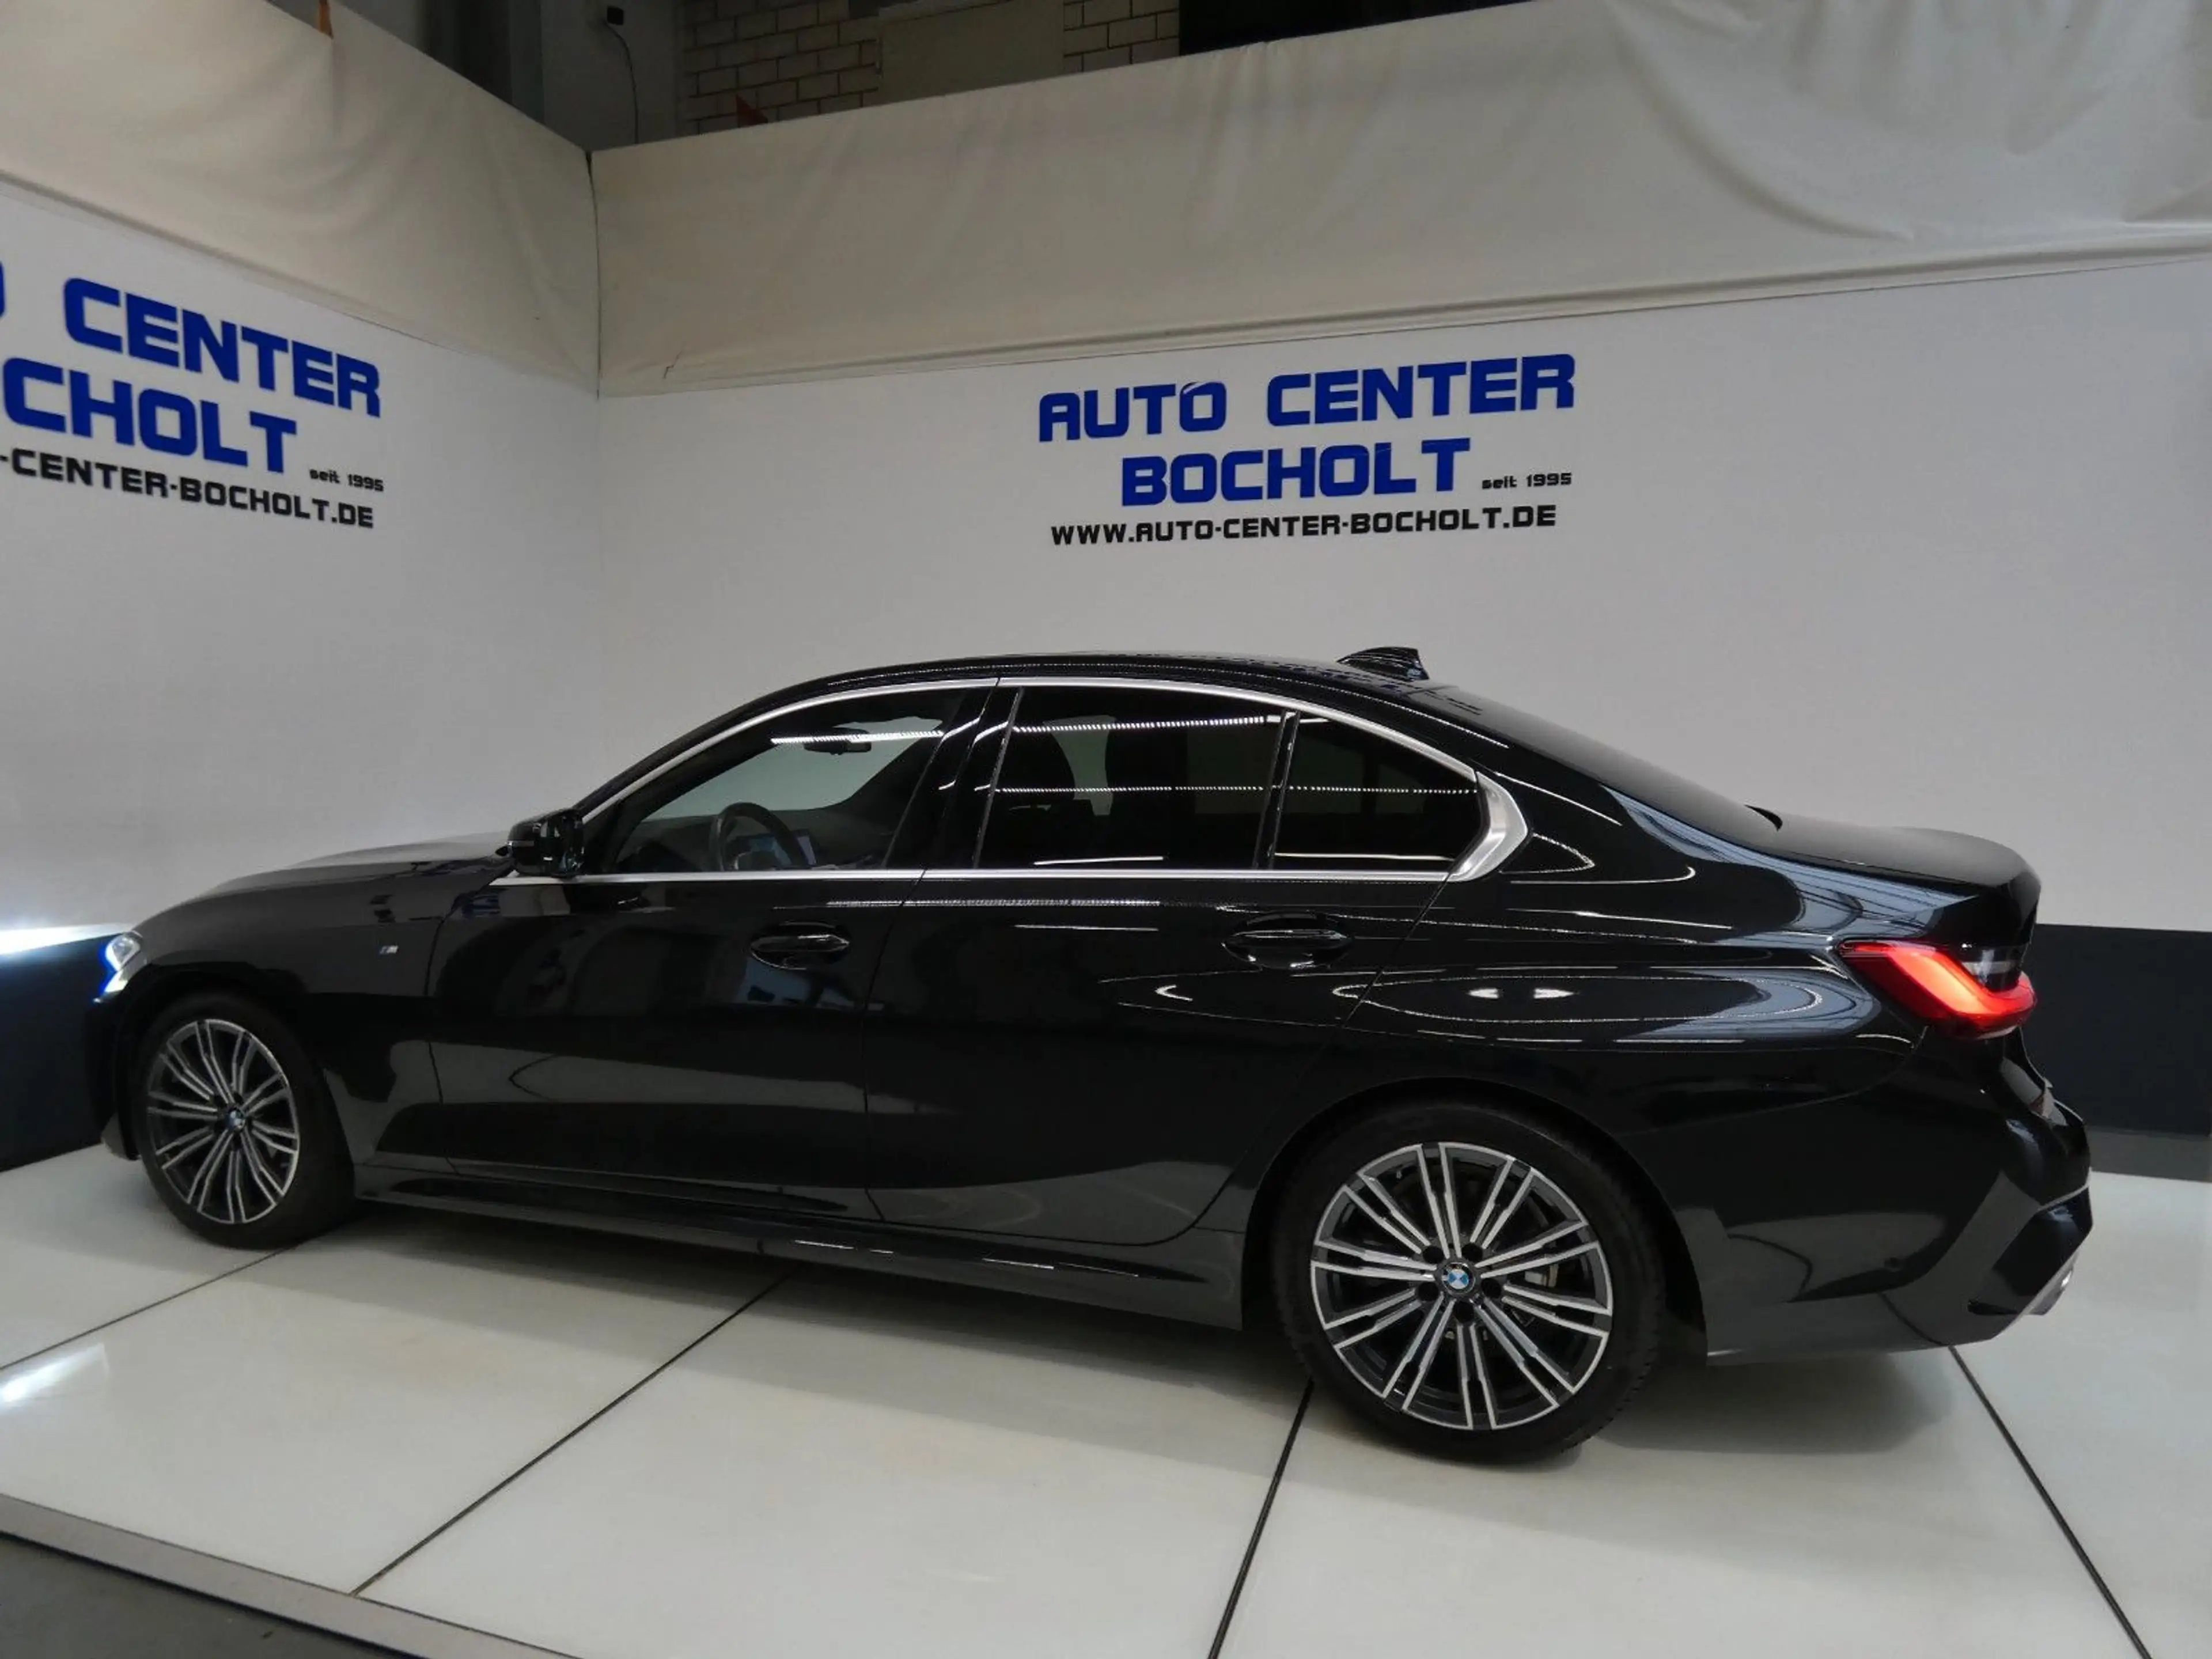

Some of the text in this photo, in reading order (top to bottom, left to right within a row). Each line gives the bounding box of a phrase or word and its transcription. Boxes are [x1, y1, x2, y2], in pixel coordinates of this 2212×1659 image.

[64, 278, 381, 418] CENTER
[2, 357, 297, 474] CHOLT
[1039, 354, 1575, 442] AUTO CENTER
[309, 468, 384, 492] seit 1995
[1122, 438, 1471, 507] BOCHOLT
[1482, 472, 1573, 490] seit 1995
[1051, 504, 1556, 546] WWW.AUTO-CENTER-BOCHOLT.DE
